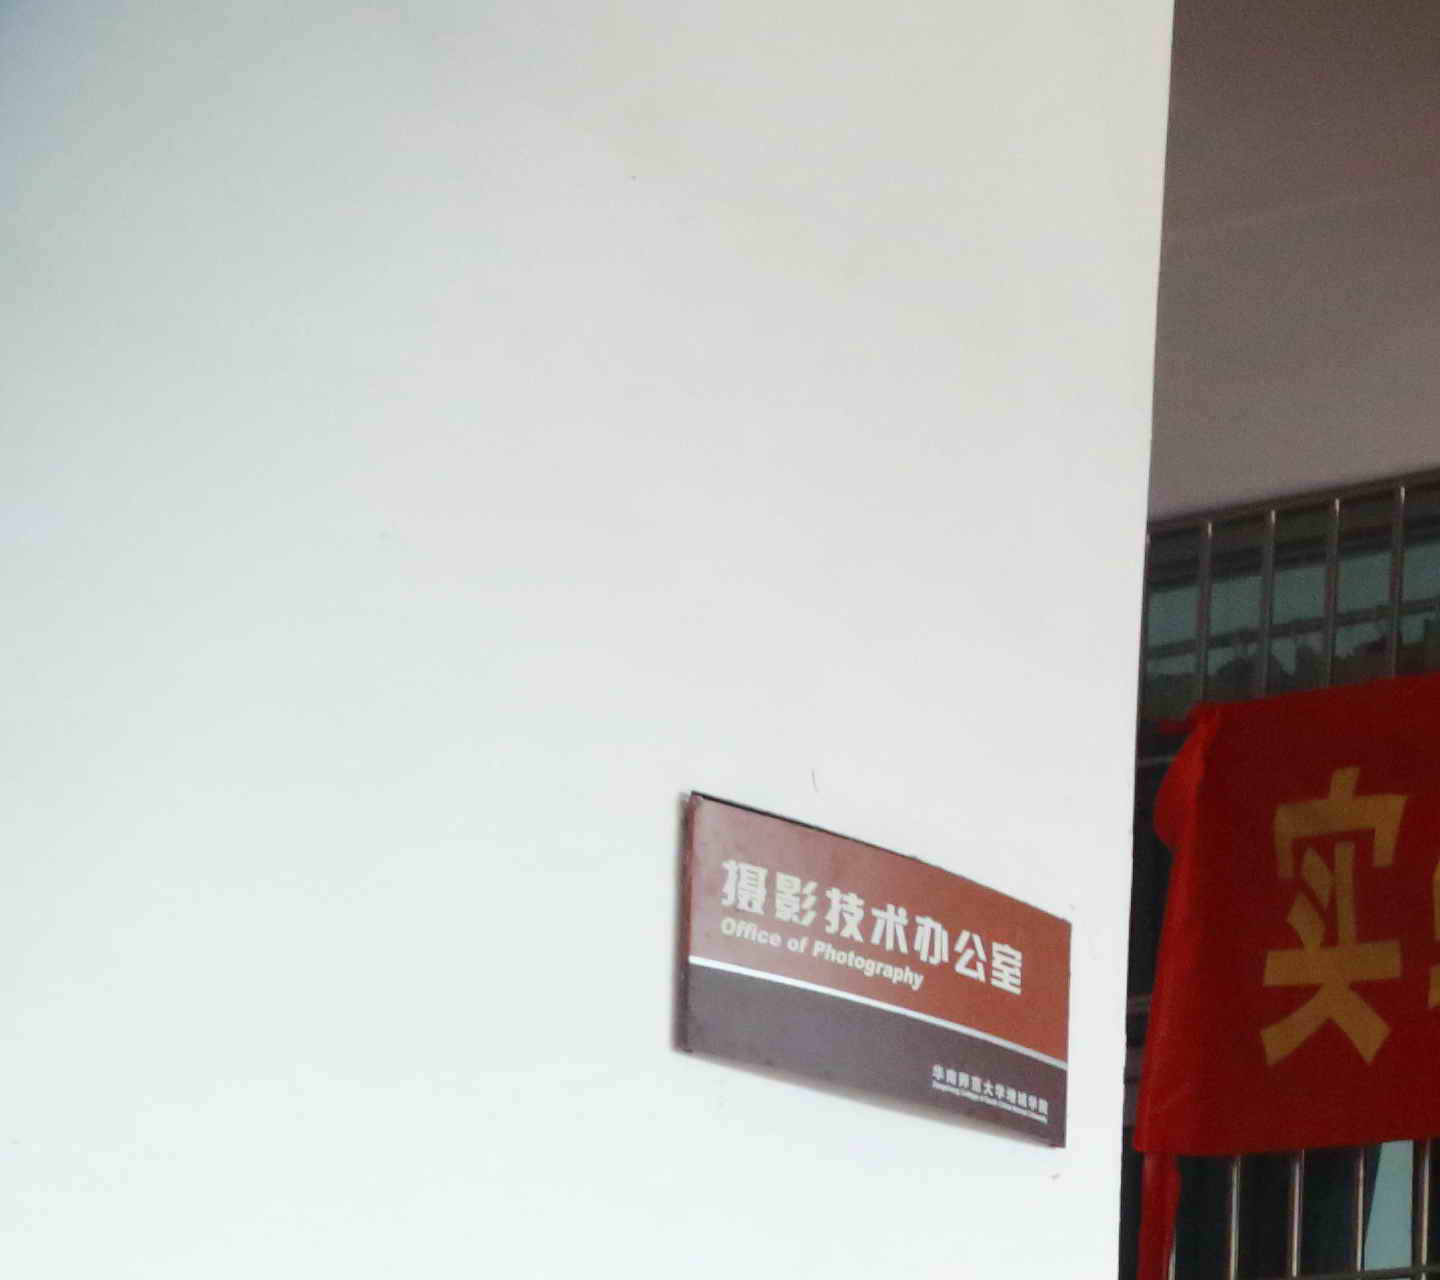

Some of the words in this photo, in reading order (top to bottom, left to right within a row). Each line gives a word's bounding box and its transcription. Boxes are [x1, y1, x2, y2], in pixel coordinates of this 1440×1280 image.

[720, 859, 1022, 995] 摄影技术办公室
[720, 917, 782, 947] Office
[787, 935, 810, 953] of
[811, 939, 925, 992] Photography
